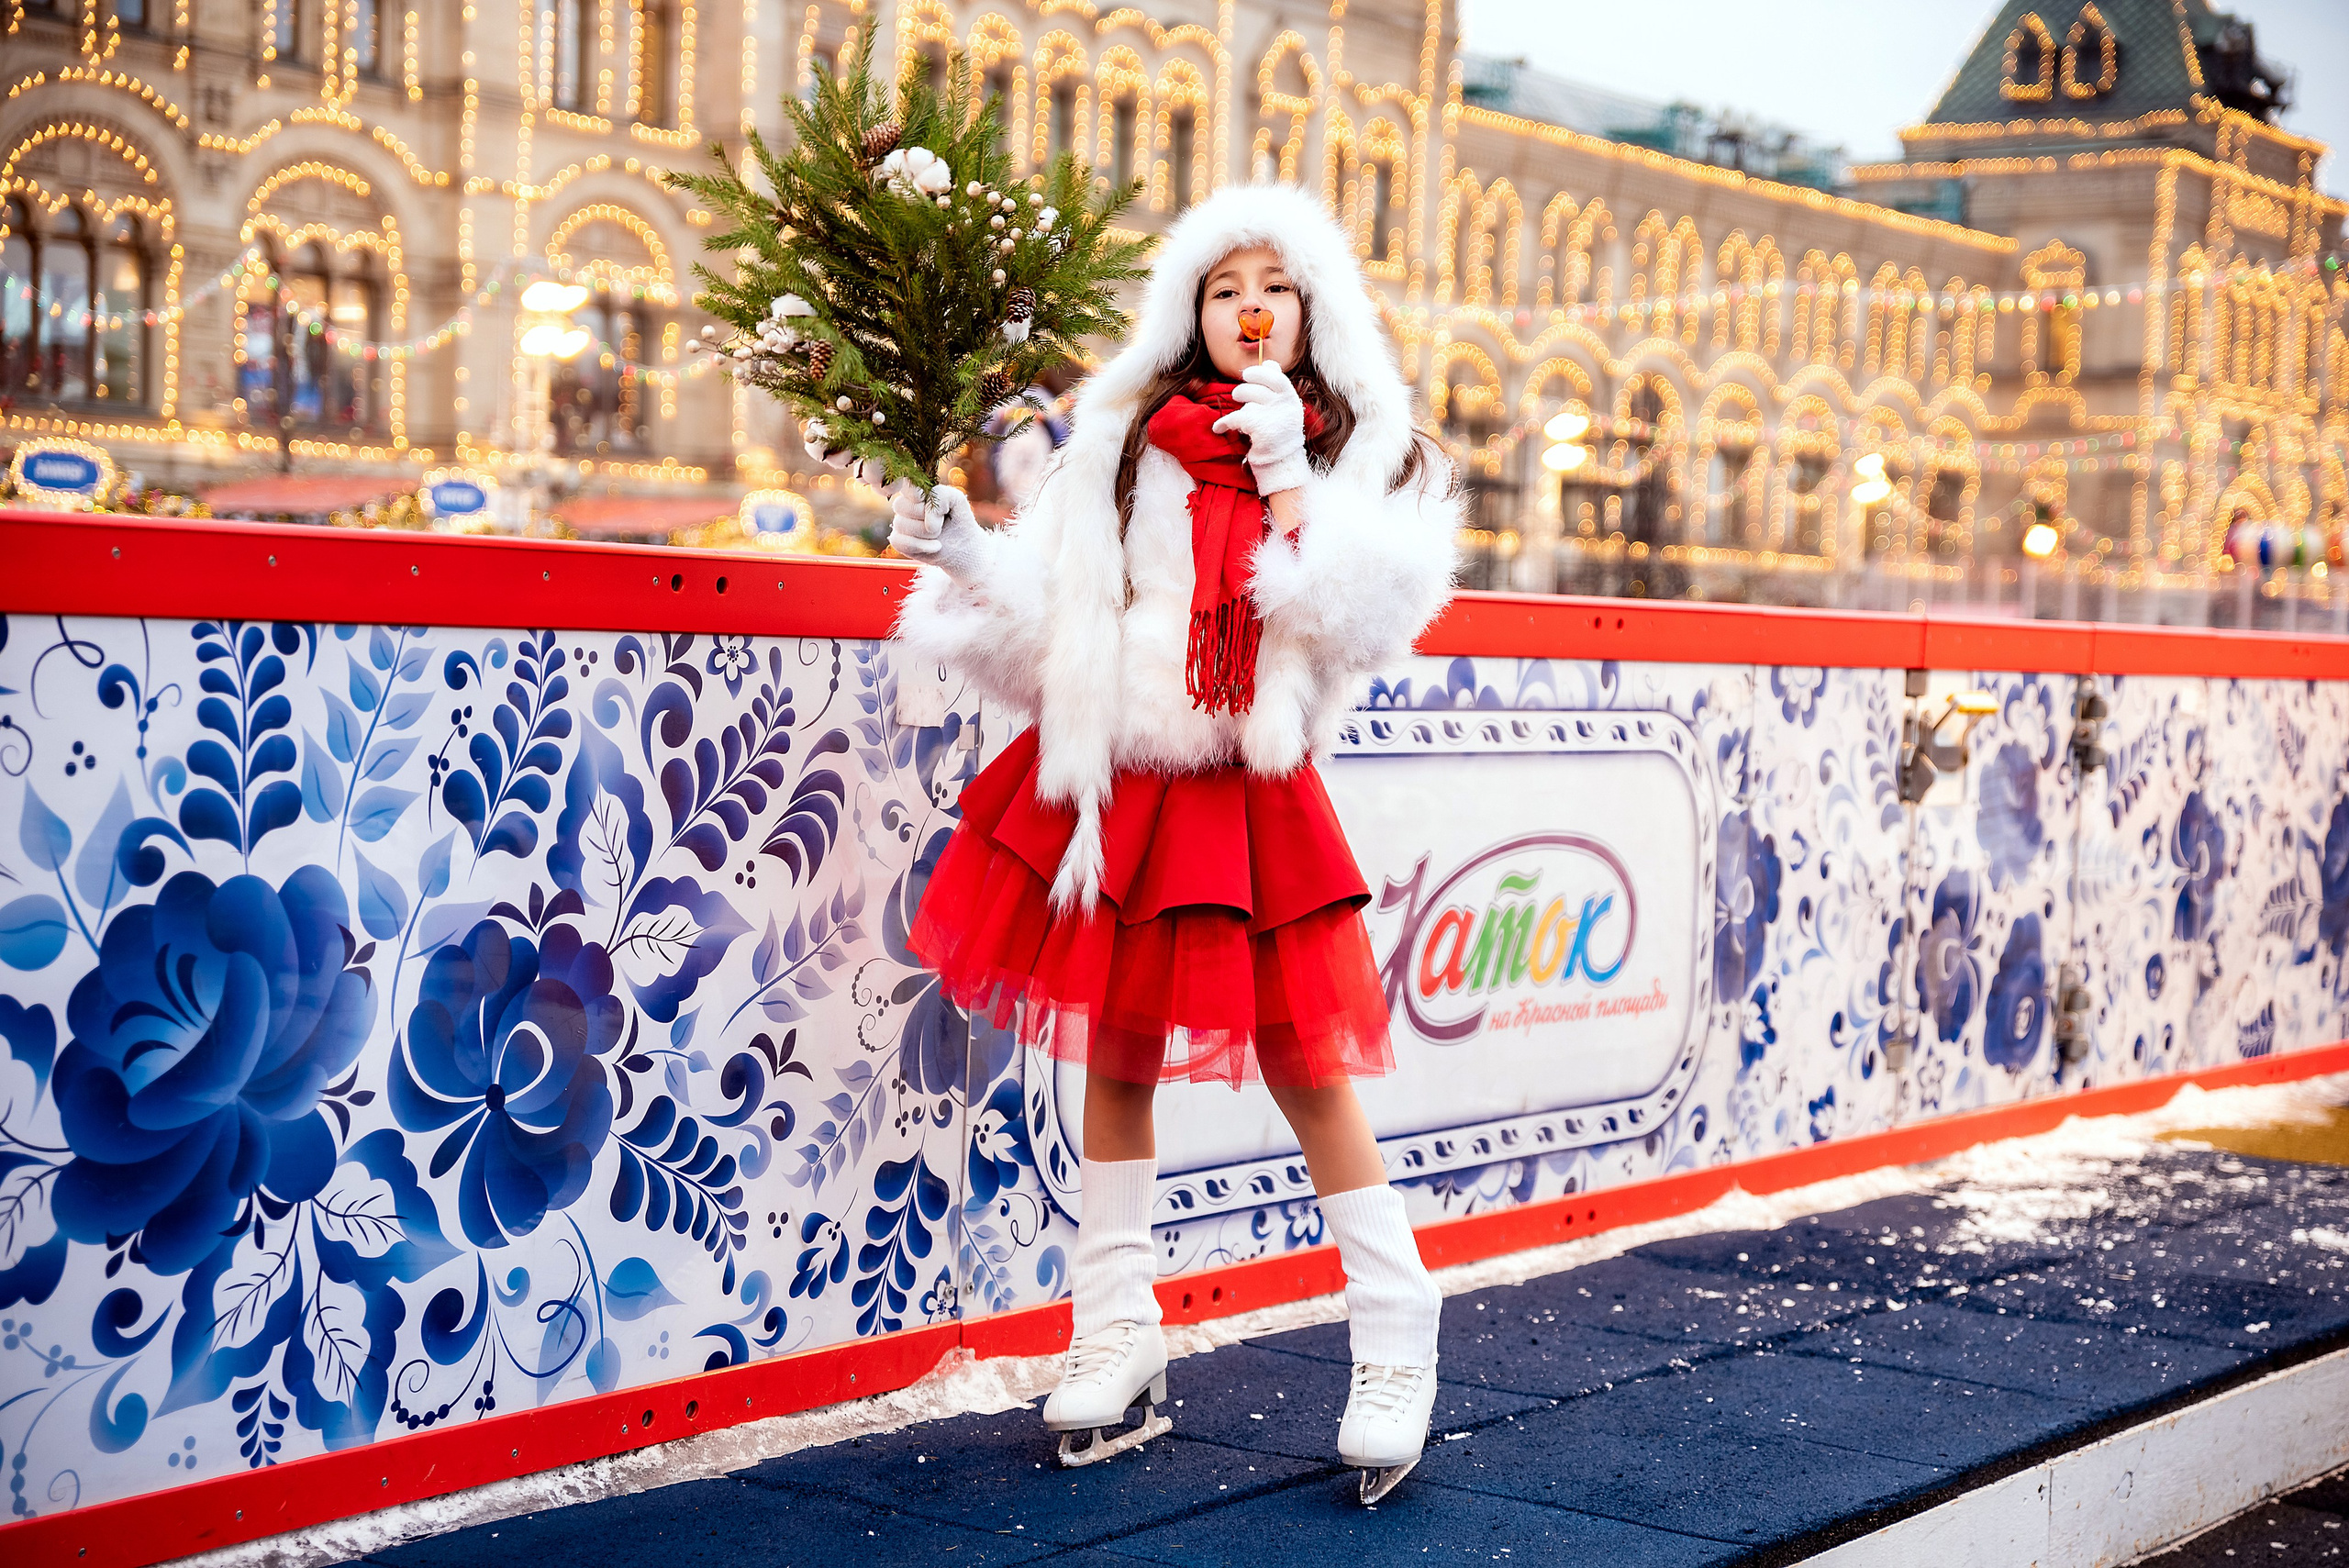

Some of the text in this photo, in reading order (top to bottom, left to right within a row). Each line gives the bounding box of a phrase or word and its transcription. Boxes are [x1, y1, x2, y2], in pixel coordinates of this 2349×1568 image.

[1376, 829, 1641, 1046] Каток
[1487, 976, 1670, 1037] на Красной площади
